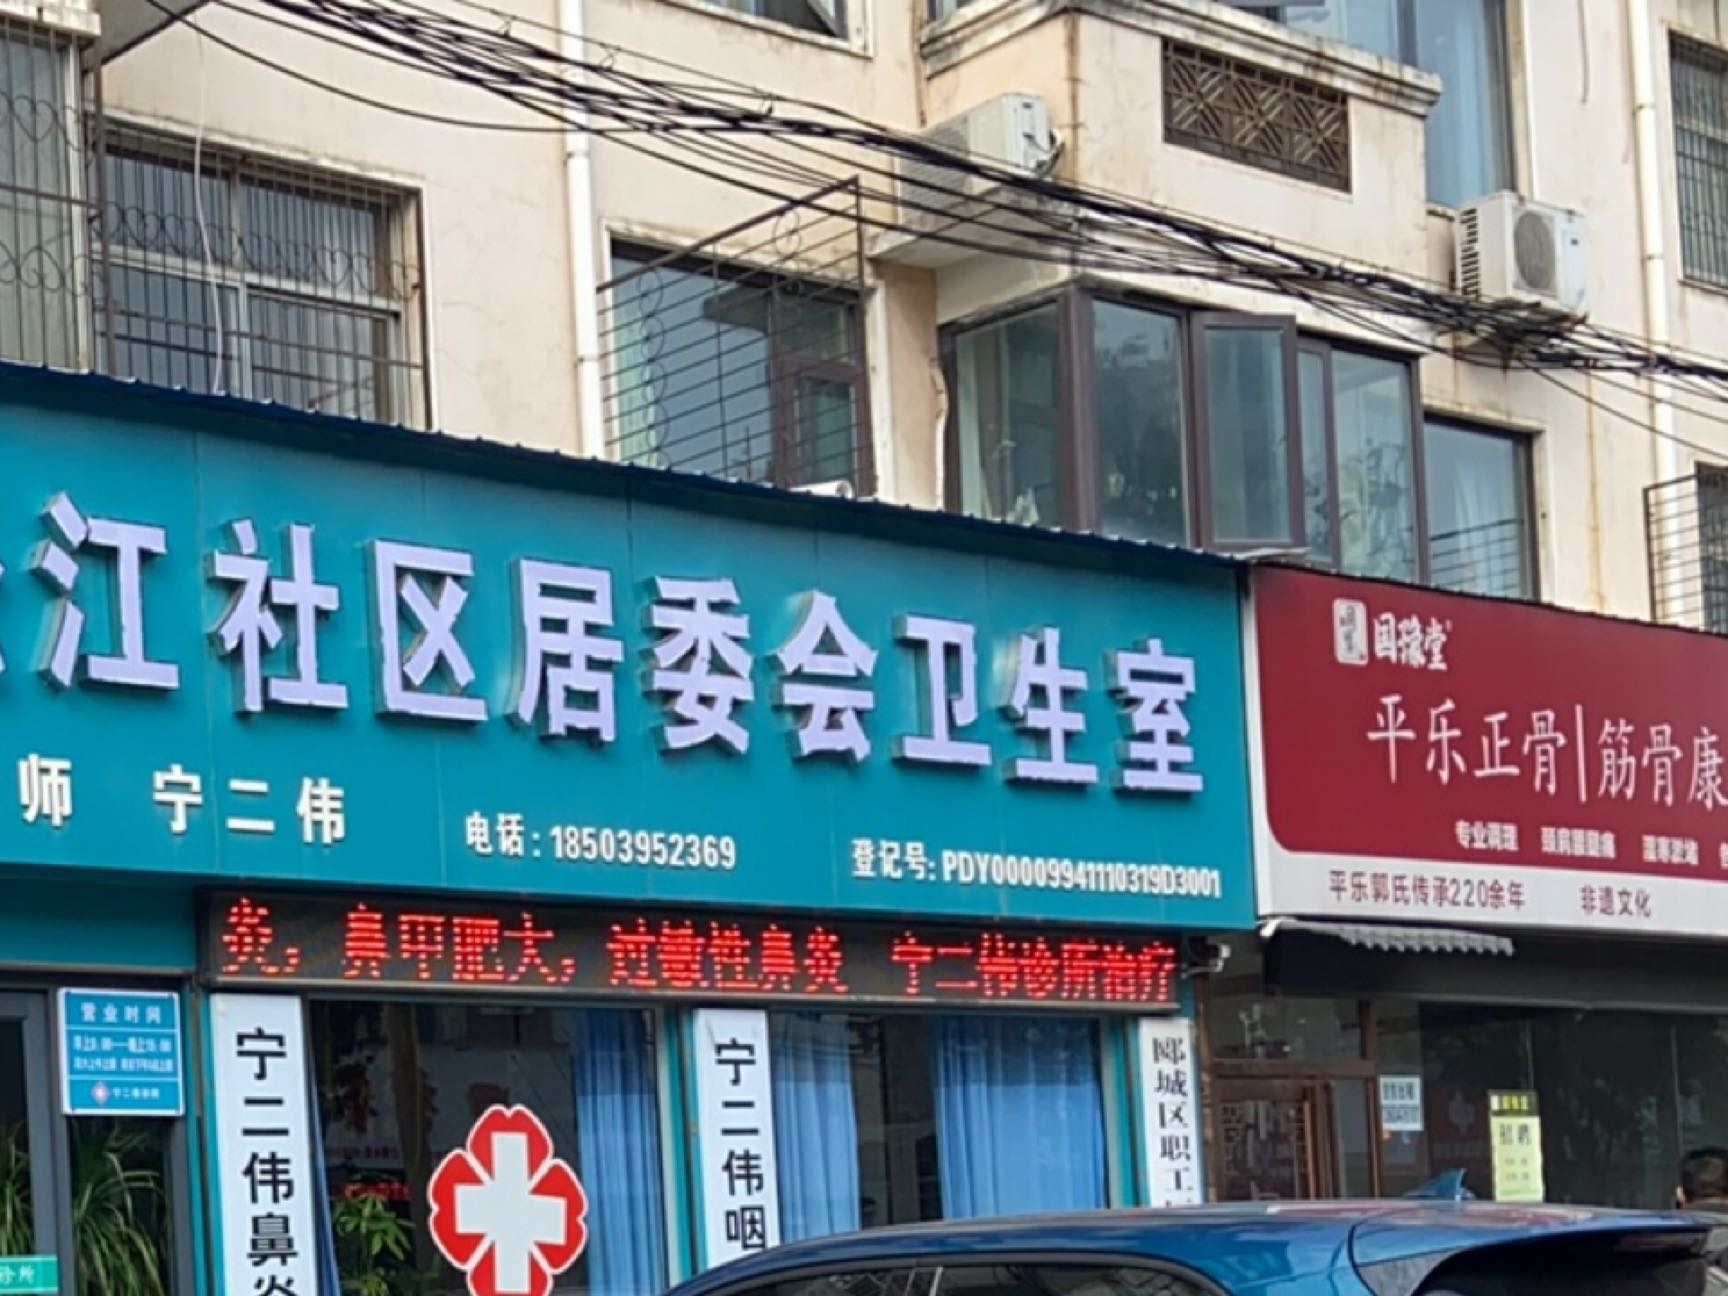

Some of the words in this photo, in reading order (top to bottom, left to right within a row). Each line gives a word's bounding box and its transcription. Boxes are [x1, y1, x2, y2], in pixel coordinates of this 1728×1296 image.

[1367, 692, 1568, 797] 平乐正骨
[1597, 717, 1728, 812] 筋骨康
[152, 764, 348, 845] 宁二伟
[1328, 868, 1527, 912] 平乐郭氏传承220余年
[1578, 884, 1653, 917] 非遗文化
[1151, 1036, 1194, 1206] 郾城区职工
